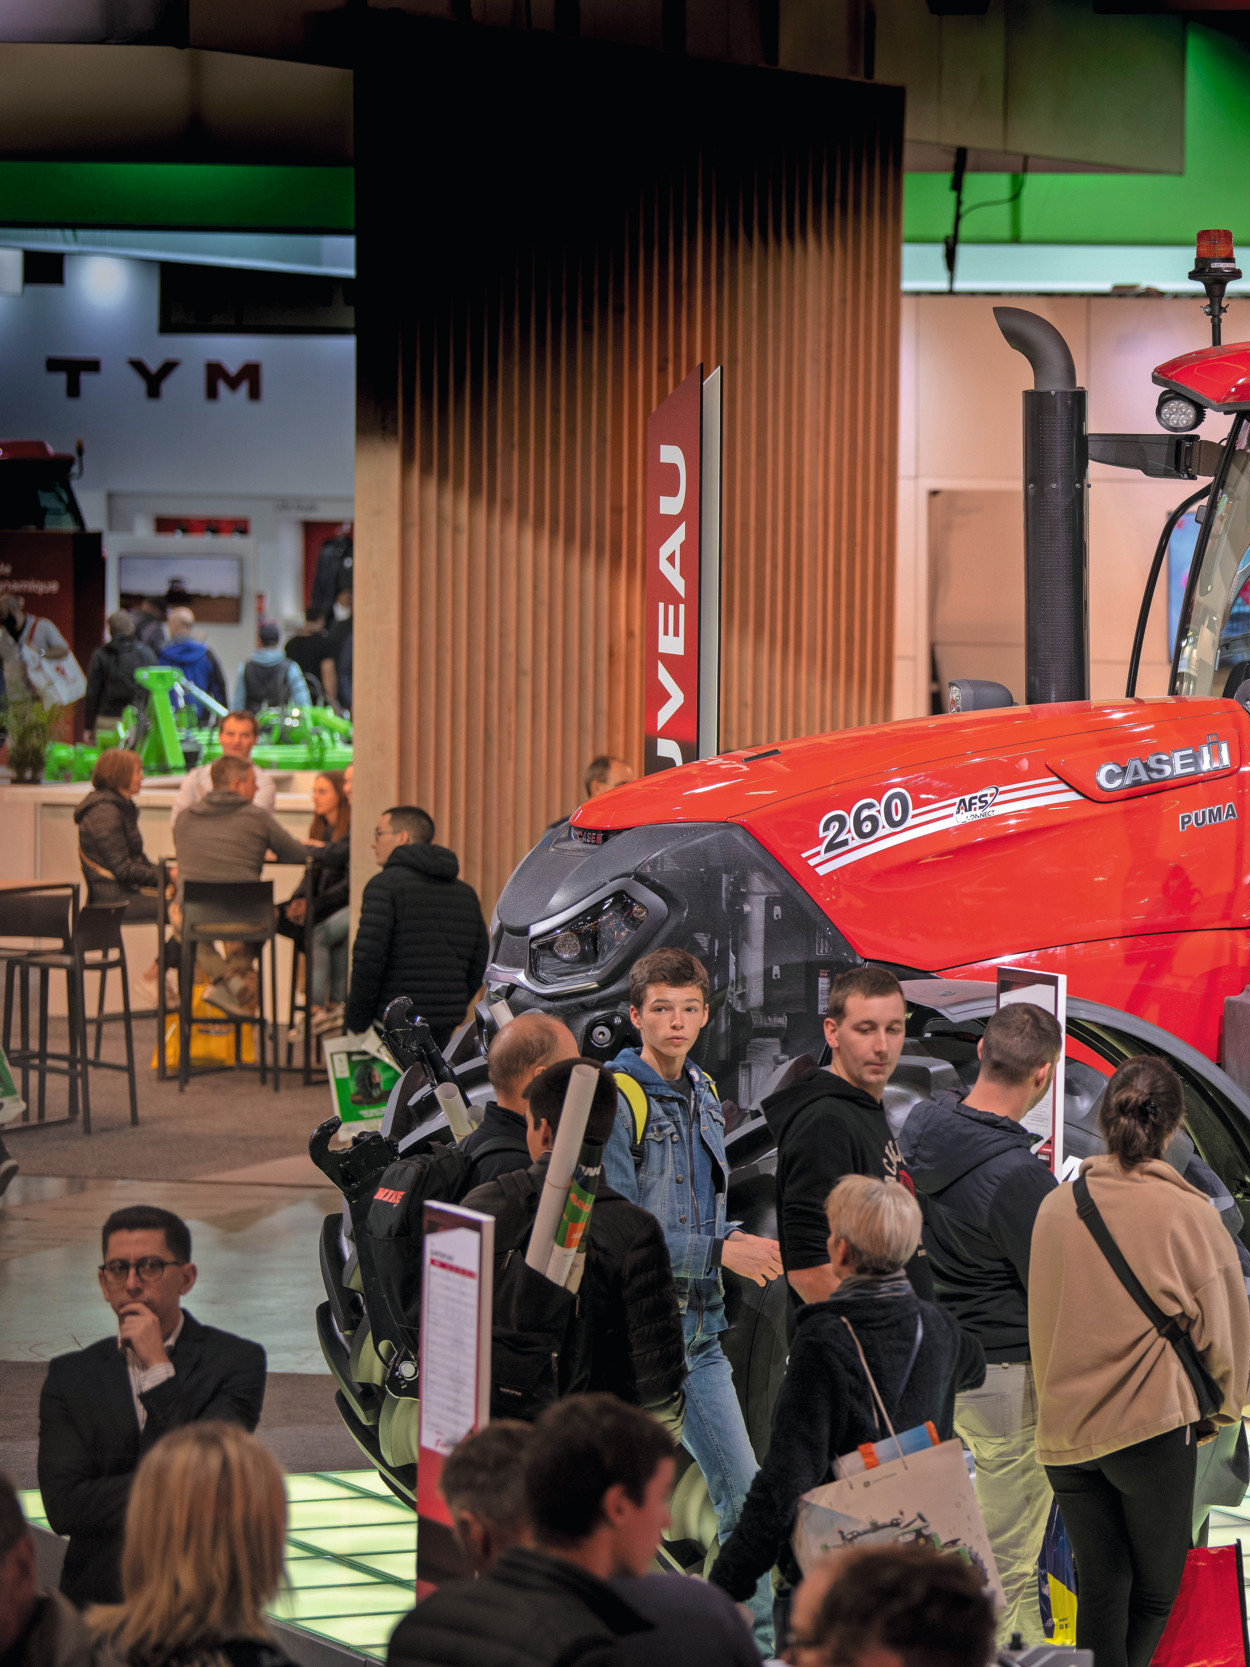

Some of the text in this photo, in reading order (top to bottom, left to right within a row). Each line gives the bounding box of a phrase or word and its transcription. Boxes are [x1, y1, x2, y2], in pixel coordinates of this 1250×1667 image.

[46, 357, 262, 400] TYM
[1097, 747, 1196, 791] CASE
[956, 793, 989, 814] AFS
[1179, 803, 1237, 831] PUMA
[577, 831, 595, 843] CASE
[820, 789, 911, 857] 260
[373, 1187, 406, 1204] NIKE
